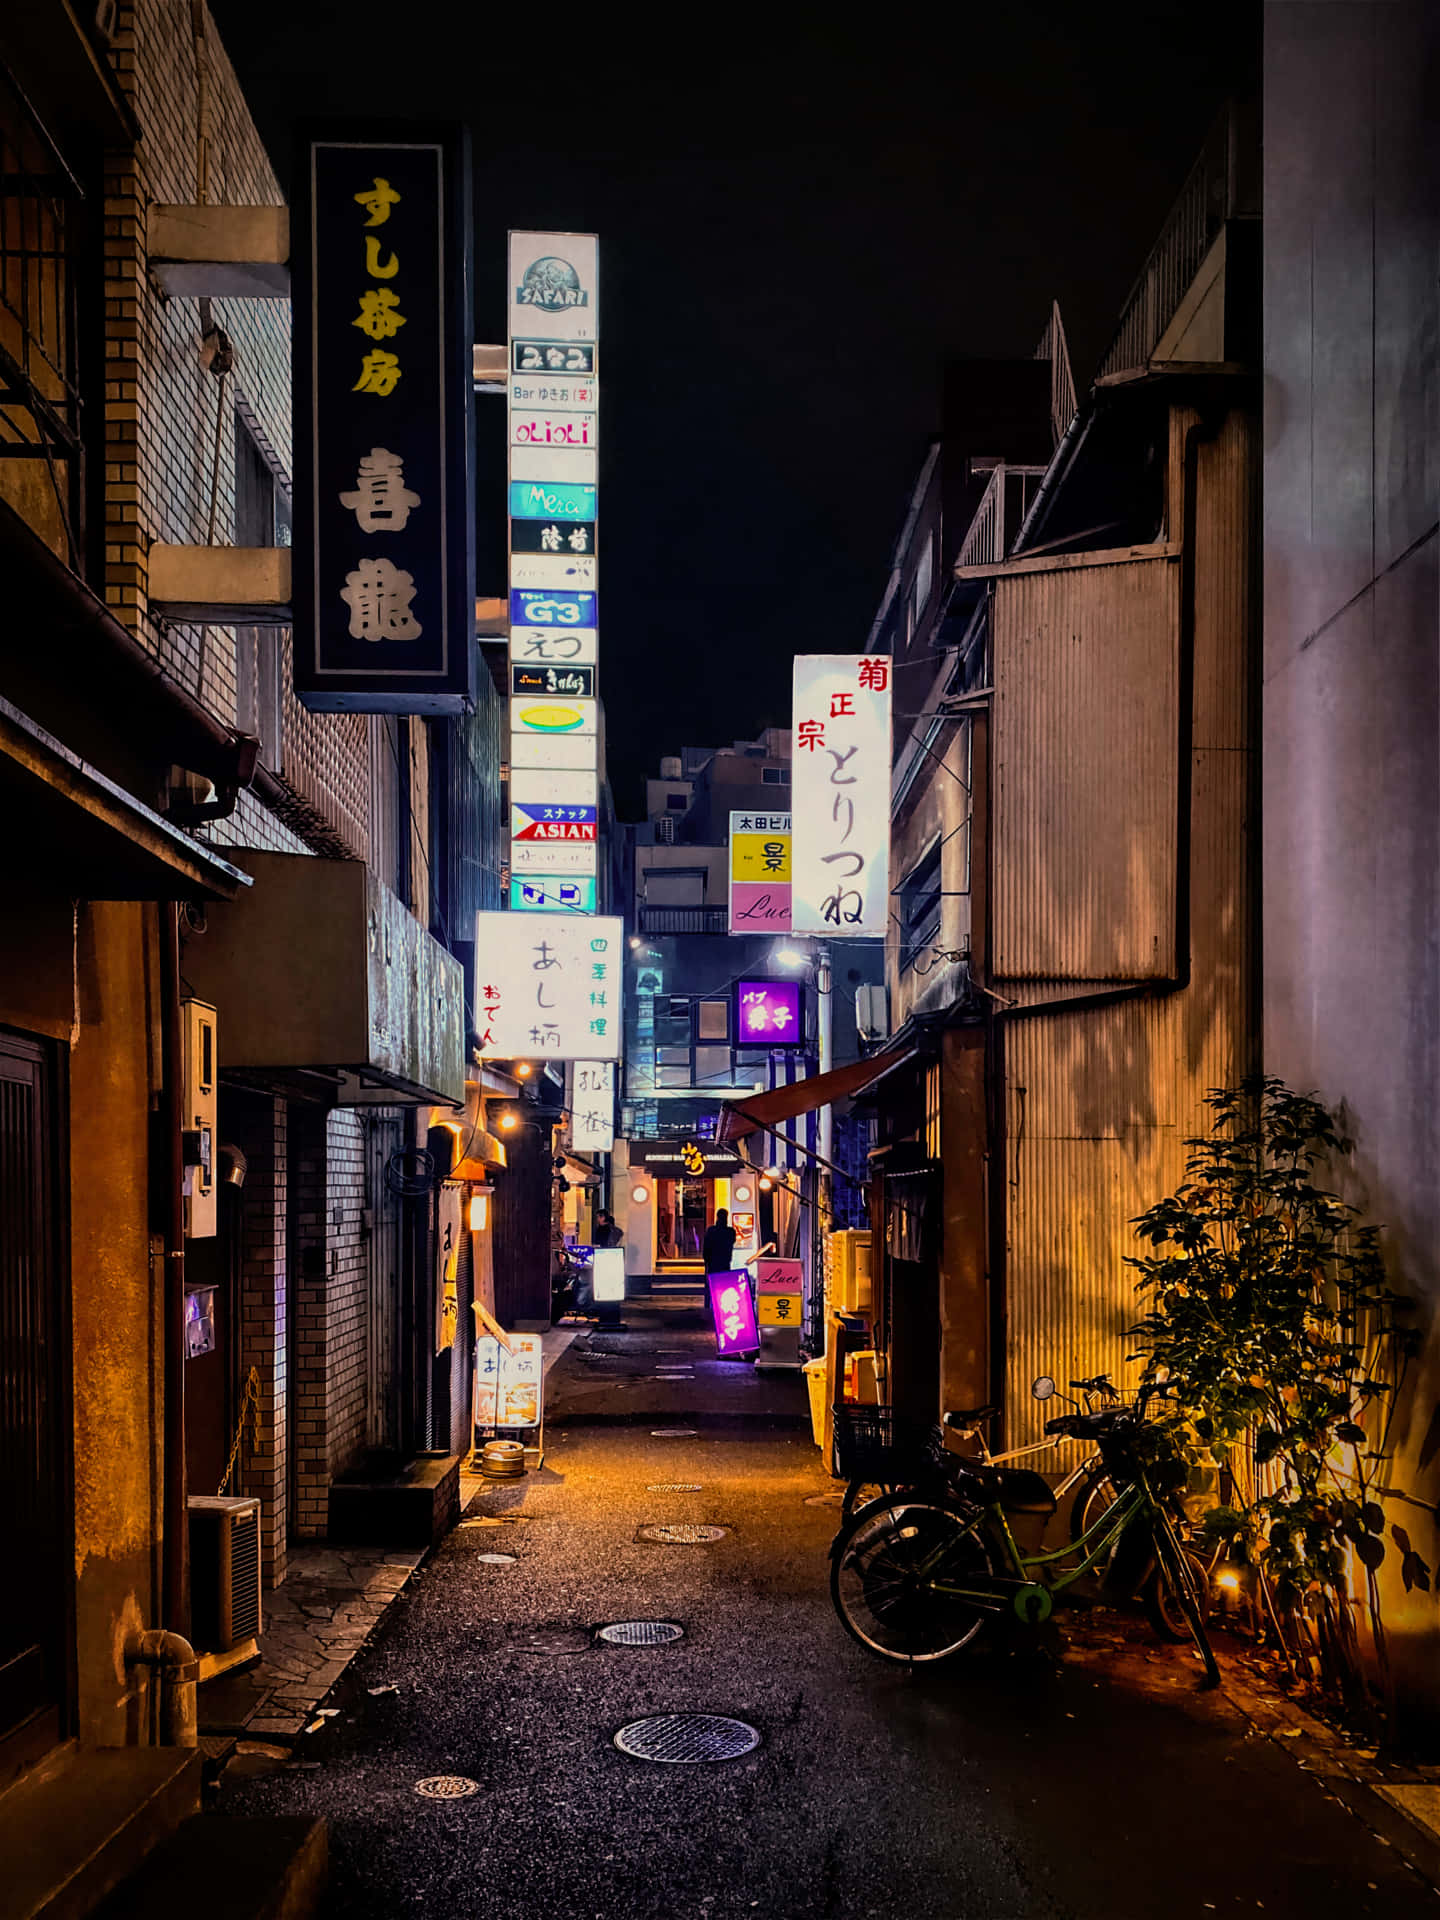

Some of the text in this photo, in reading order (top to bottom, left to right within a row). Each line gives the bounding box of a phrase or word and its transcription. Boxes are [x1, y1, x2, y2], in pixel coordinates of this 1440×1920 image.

[521, 287, 584, 306] SAFARI
[520, 346, 589, 371] みなみ
[513, 386, 534, 399] Bar
[524, 599, 581, 624] G3
[523, 632, 582, 658] えつ
[543, 807, 588, 820] スナック
[533, 823, 594, 839] ASIAN
[820, 745, 865, 926] とりつね
[761, 842, 787, 873] 景
[589, 938, 608, 1037] 四季料理
